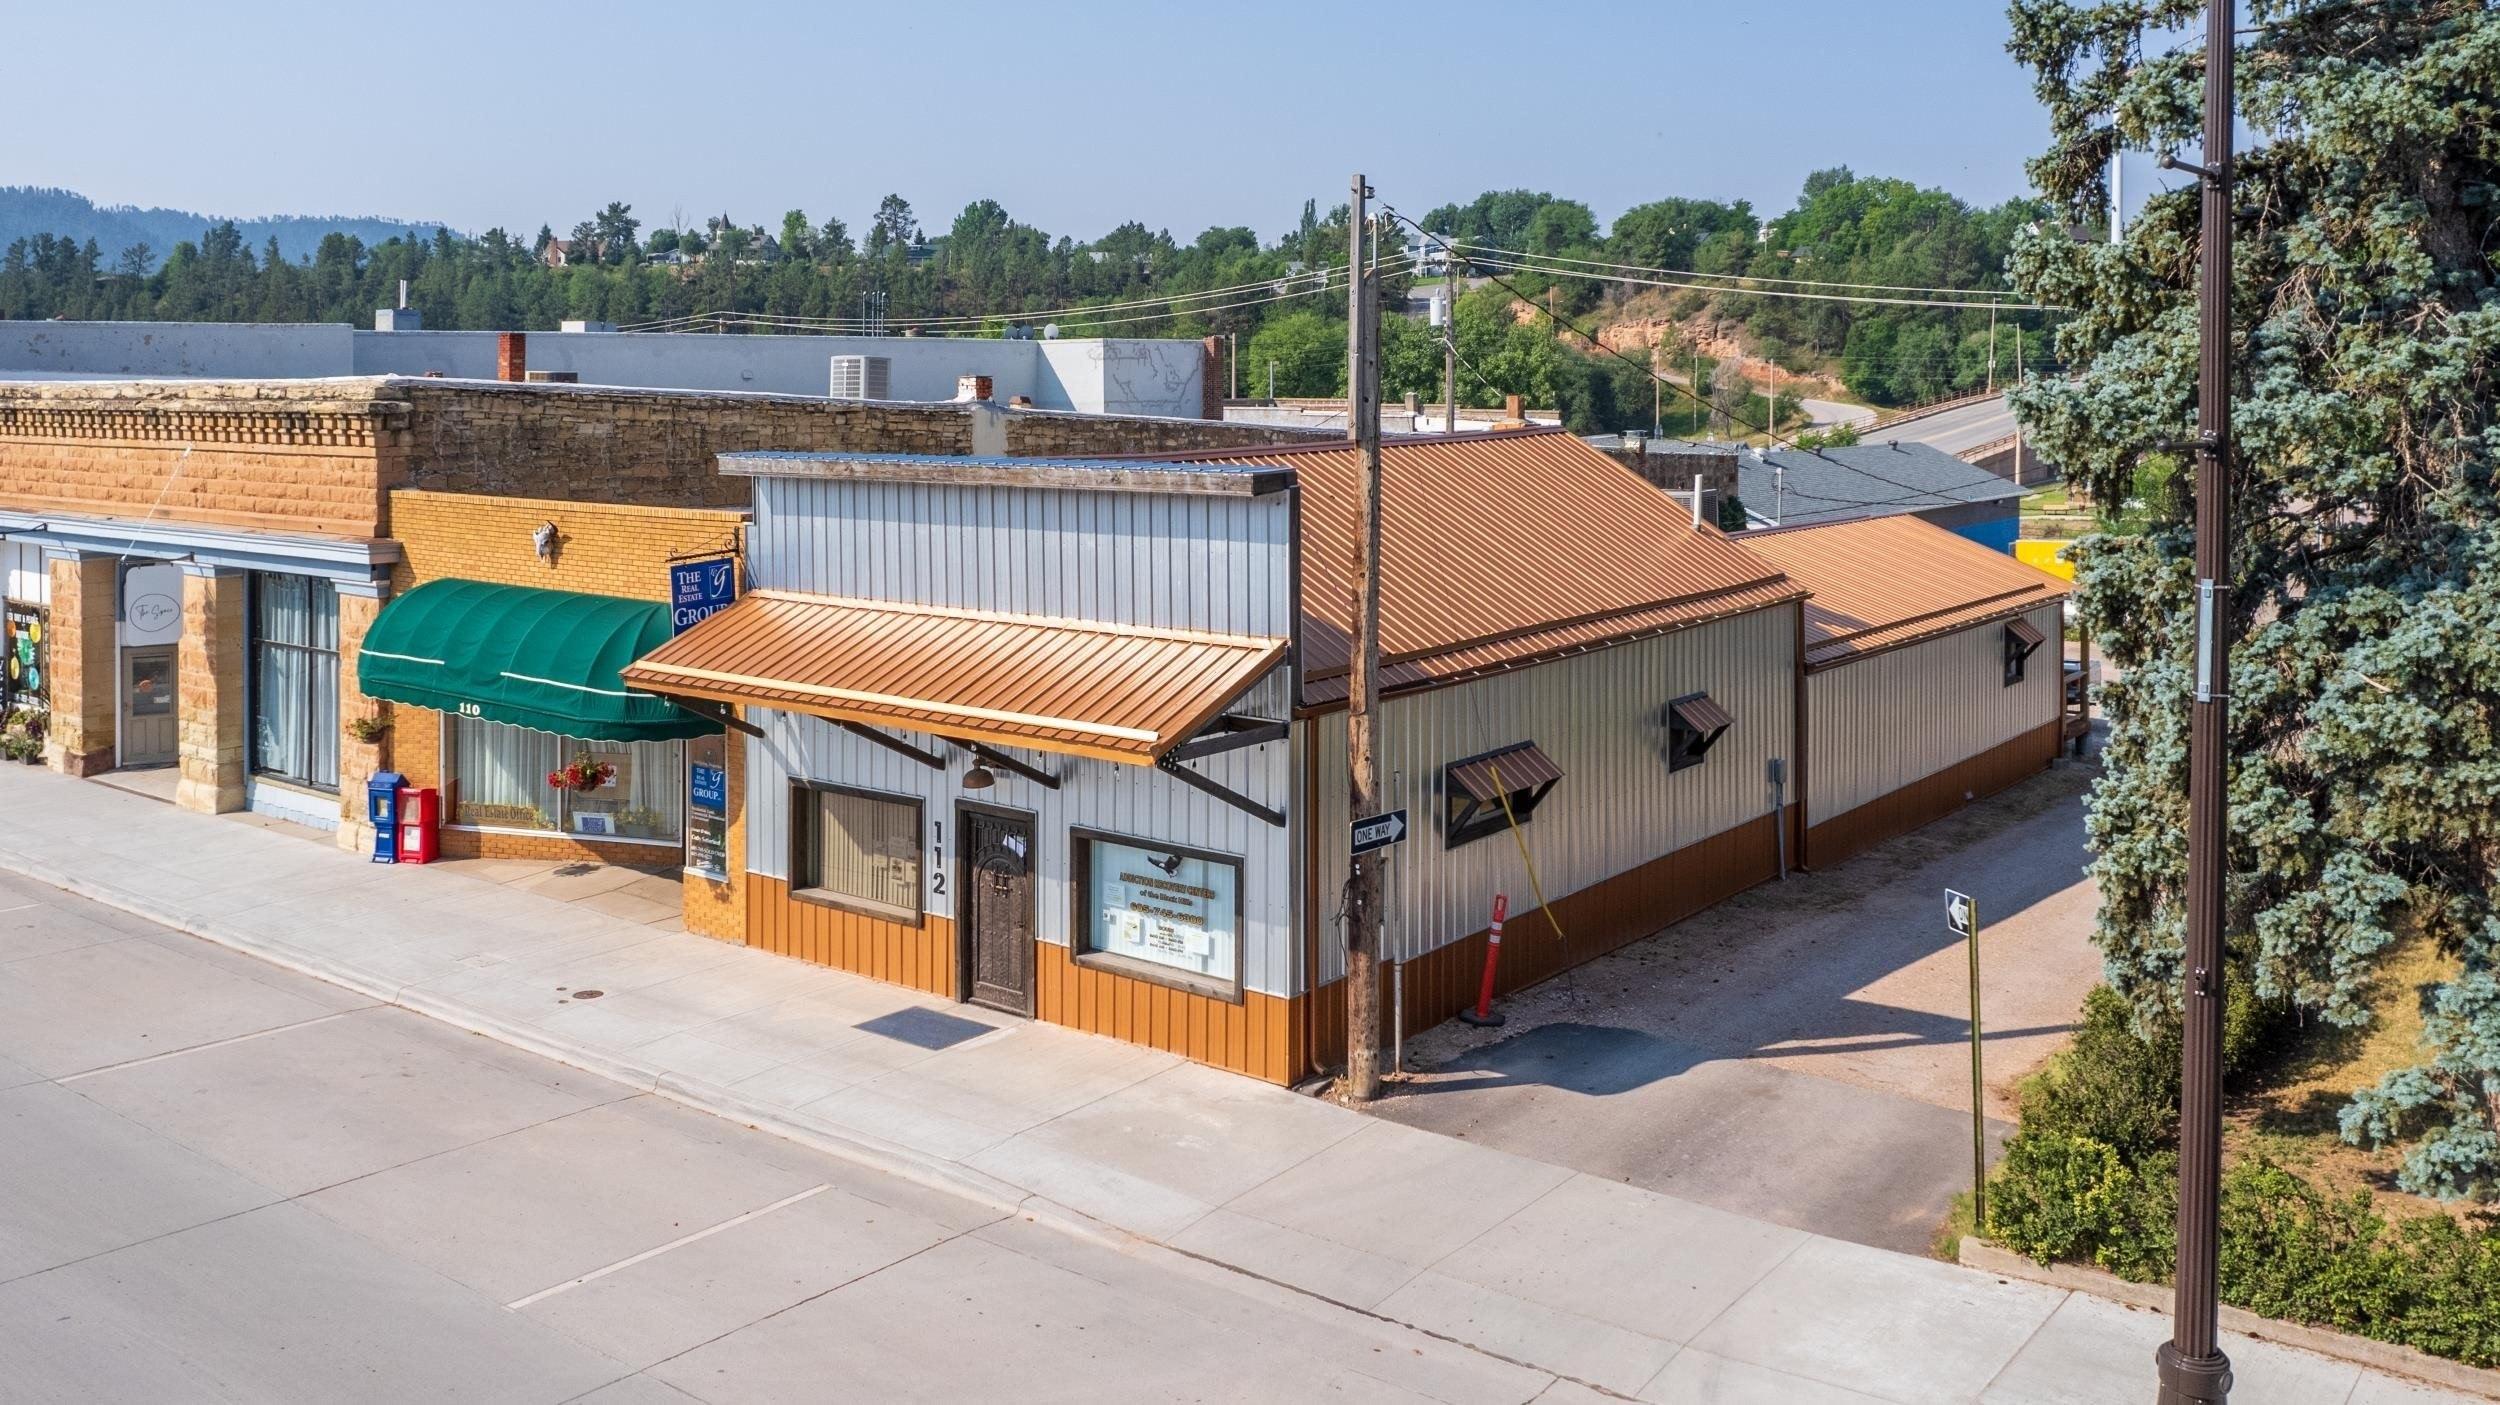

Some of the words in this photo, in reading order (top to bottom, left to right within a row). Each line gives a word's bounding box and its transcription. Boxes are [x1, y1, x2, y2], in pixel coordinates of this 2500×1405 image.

[677, 571, 702, 585] THE
[681, 584, 699, 594] REAL
[678, 593, 703, 604] ESTATE
[136, 604, 149, 619] The
[459, 702, 481, 716] 110
[693, 787, 719, 799] GROUP
[464, 804, 483, 817] Real
[484, 806, 509, 820] Estate
[510, 808, 534, 821] Office
[1357, 828, 1372, 843] ONE
[1375, 823, 1390, 838] WAY
[933, 821, 945, 895] 112
[1119, 872, 1154, 887] ADDICTION
[1187, 886, 1216, 900] CENTERS
[1139, 889, 1147, 897] of
[1148, 891, 1159, 900] the
